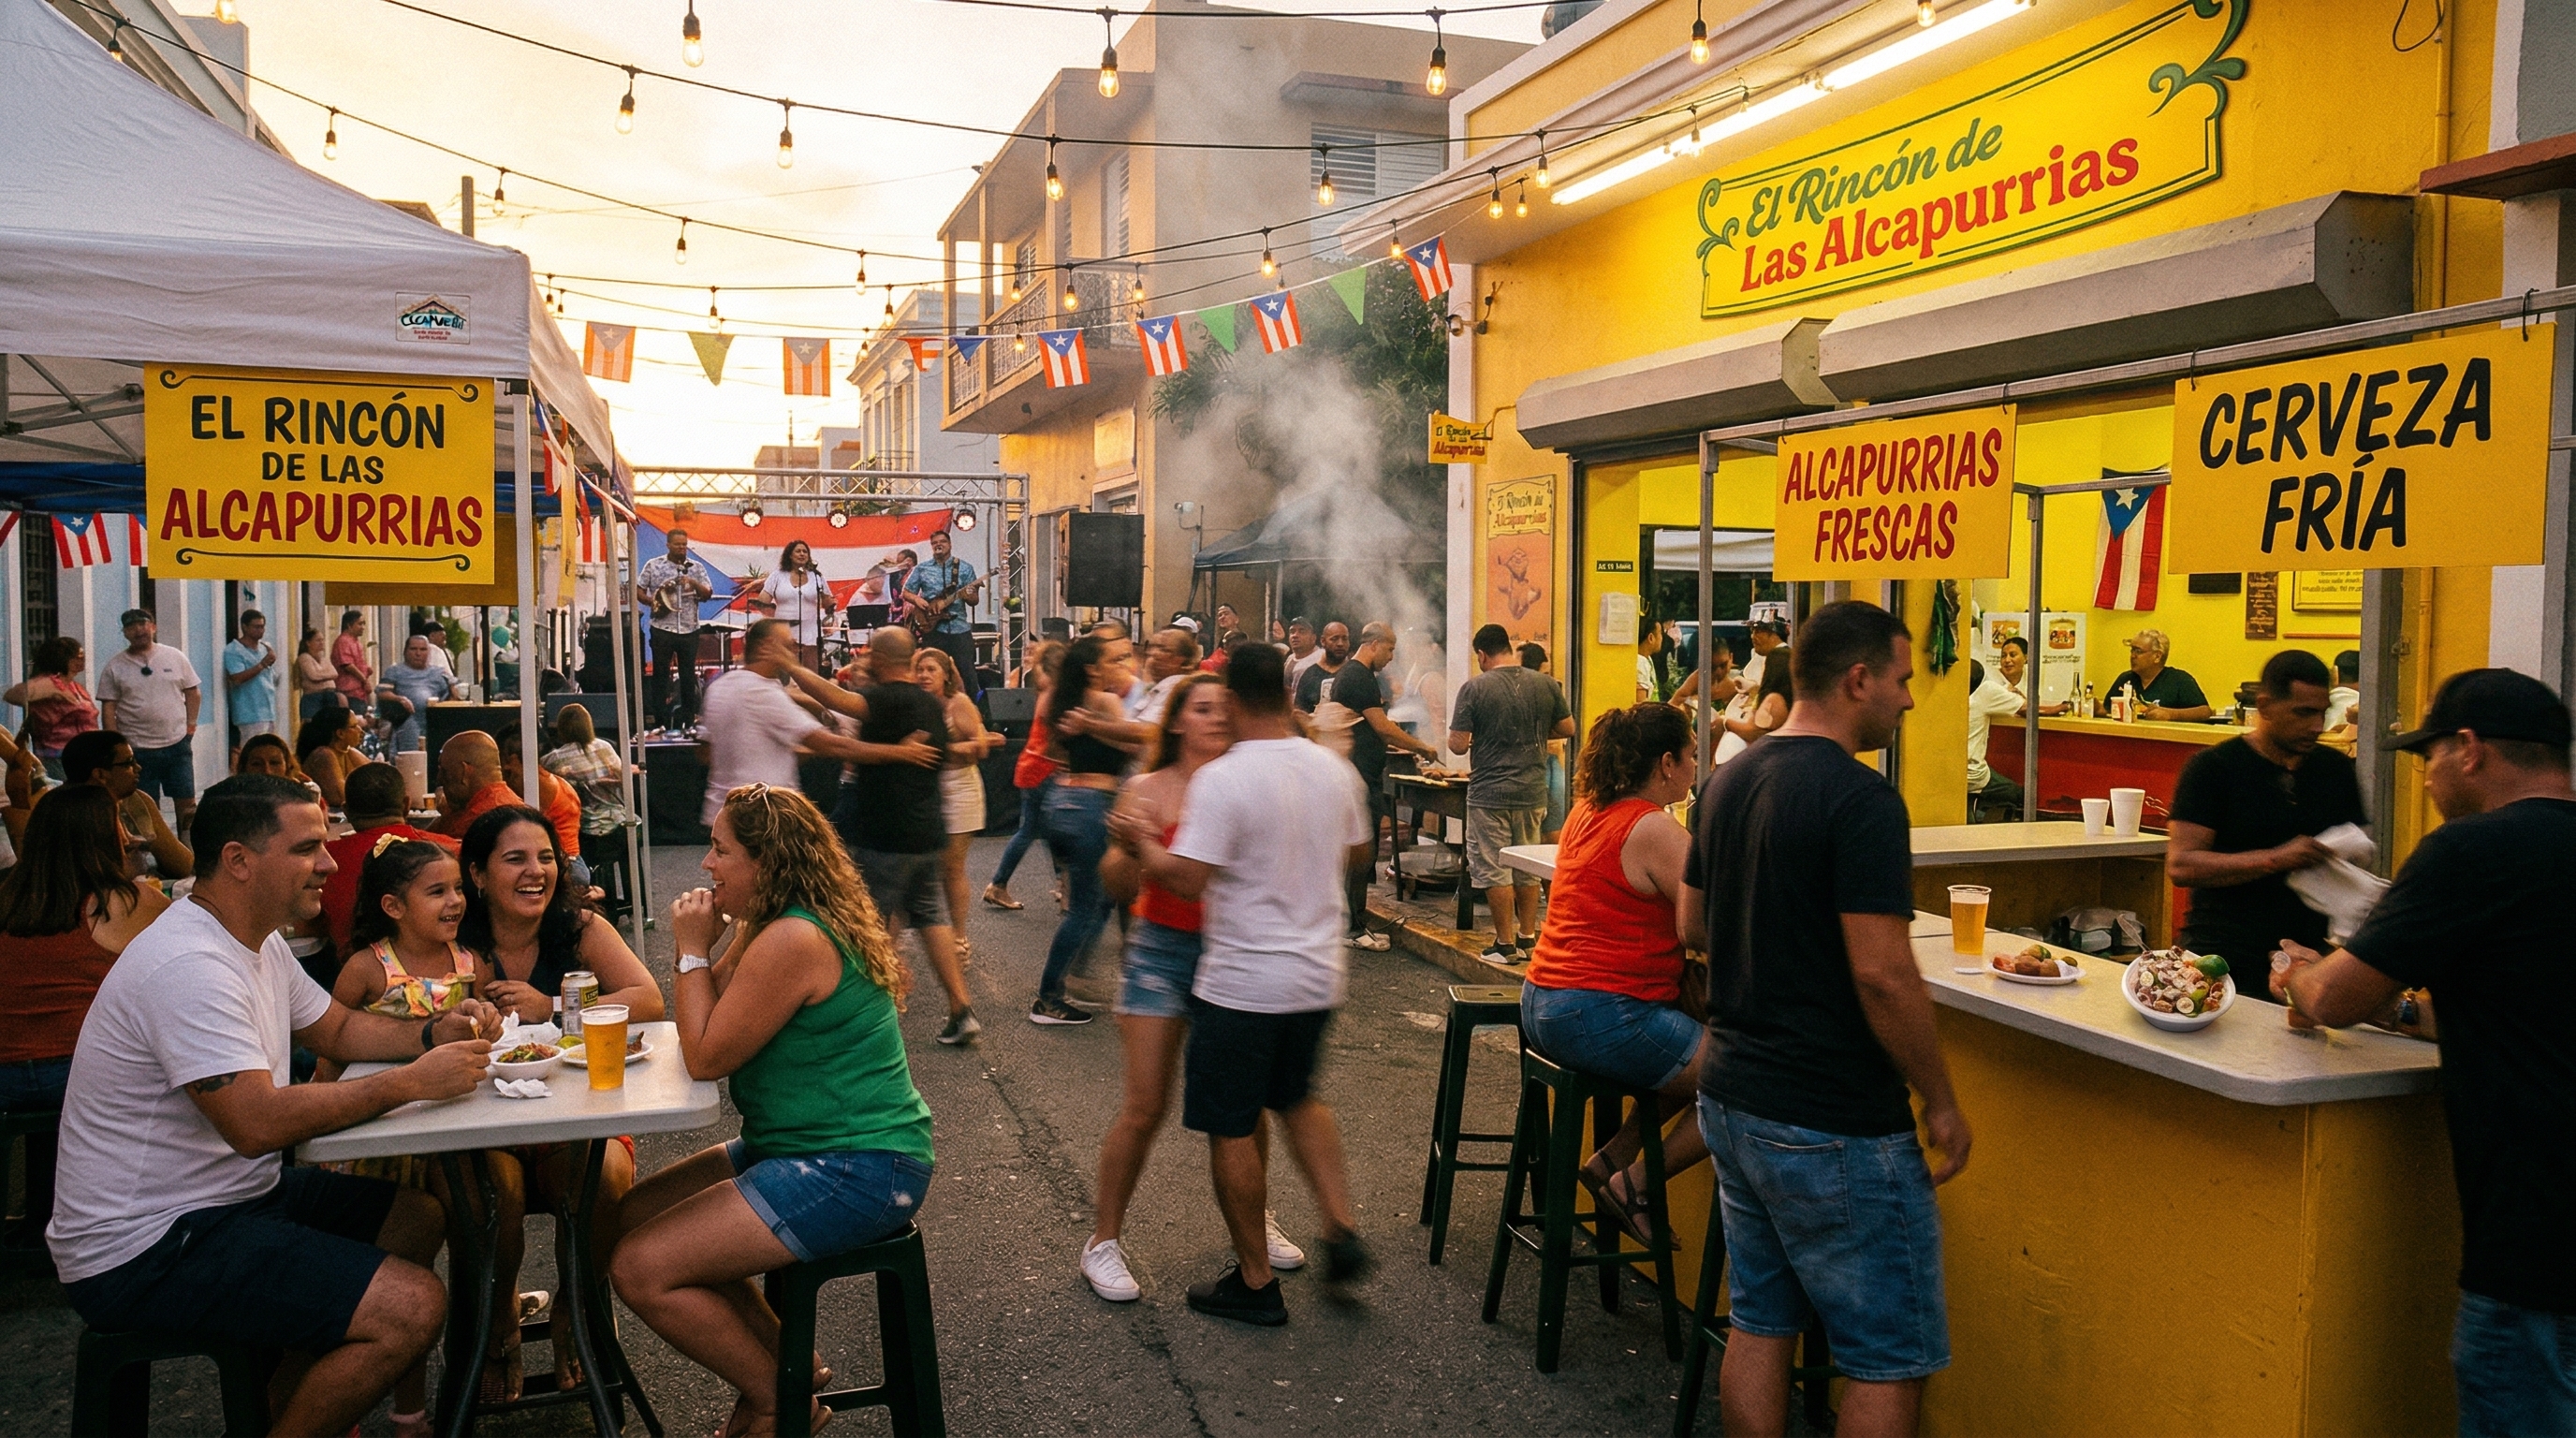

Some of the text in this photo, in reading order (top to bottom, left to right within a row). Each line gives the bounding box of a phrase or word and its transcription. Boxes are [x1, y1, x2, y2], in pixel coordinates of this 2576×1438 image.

[1740, 138, 2140, 292] Las Alcapurrias
[1746, 117, 2003, 238] El Rincón de
[190, 390, 446, 450] EL RINCÓN
[2200, 357, 2492, 470] CERVEZA
[261, 450, 385, 485] DE LAS
[1782, 426, 2003, 506] ALCAPURRIAS
[2261, 452, 2408, 555] FRÍA
[160, 488, 483, 548] ALCAPURRIAS
[1813, 499, 1959, 564] FRESCAS
